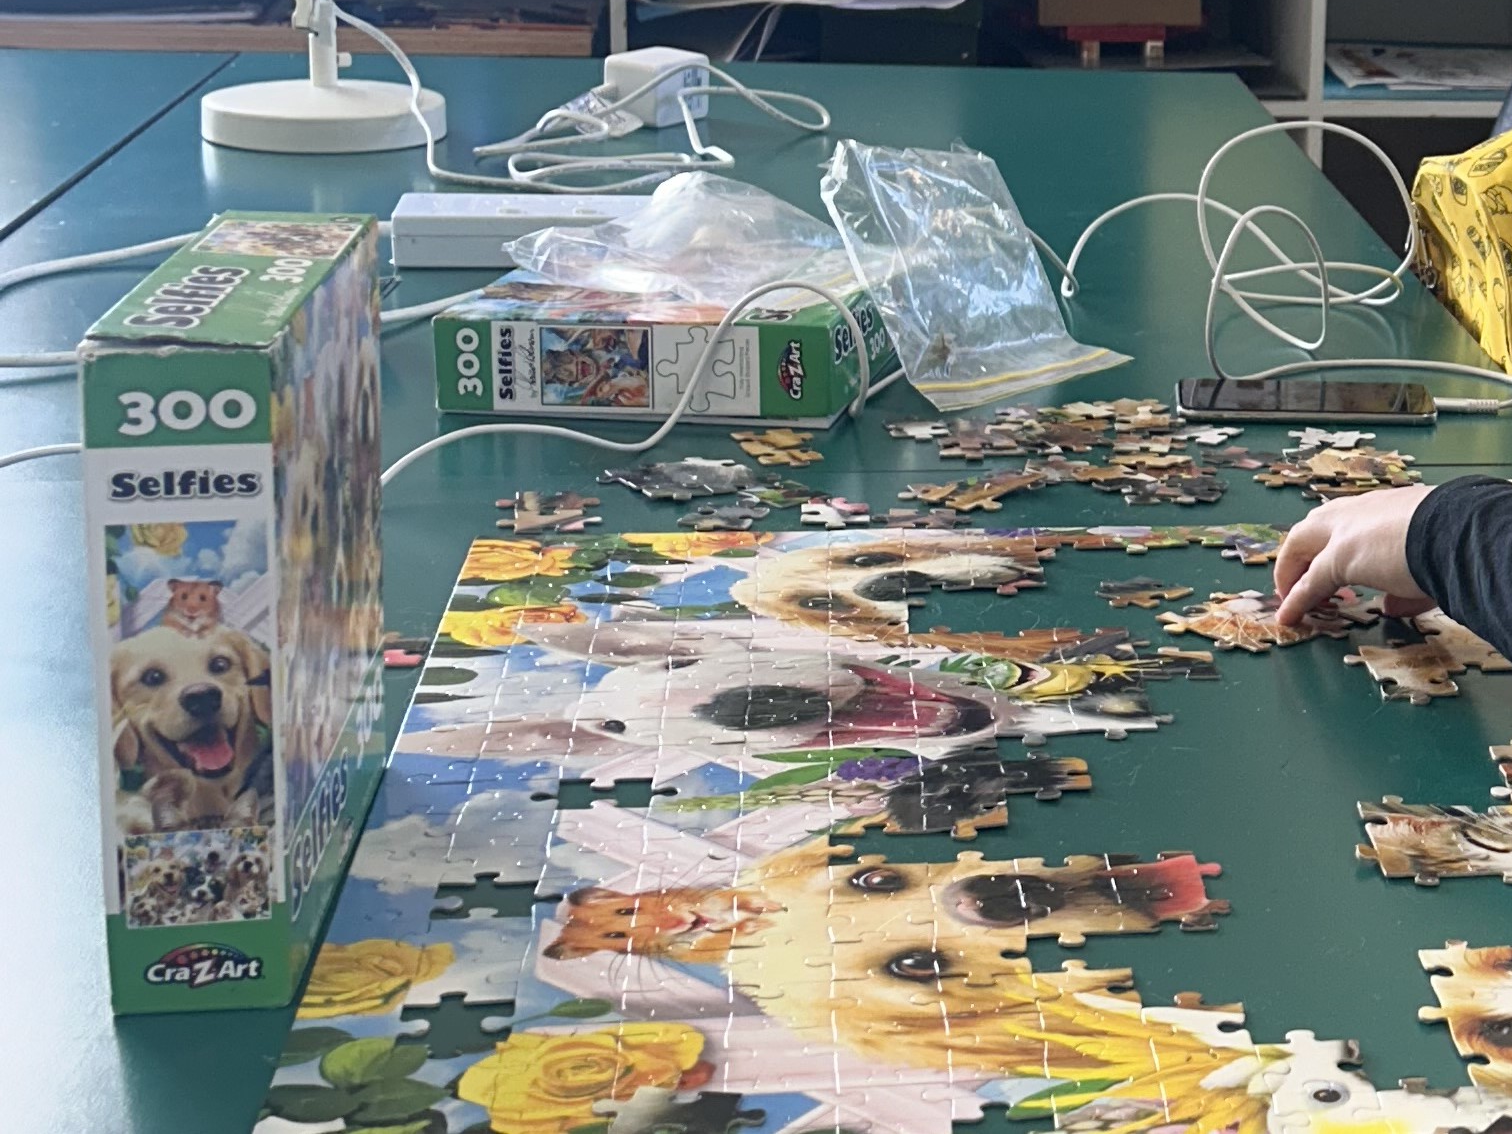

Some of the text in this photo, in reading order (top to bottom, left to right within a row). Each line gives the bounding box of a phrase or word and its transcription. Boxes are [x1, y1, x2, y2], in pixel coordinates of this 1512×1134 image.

[123, 264, 250, 330] Selfies
[259, 257, 313, 284] 300
[456, 327, 484, 397] 300
[498, 326, 514, 401] Selfies
[117, 389, 257, 436] 300
[109, 469, 261, 500] Selfies
